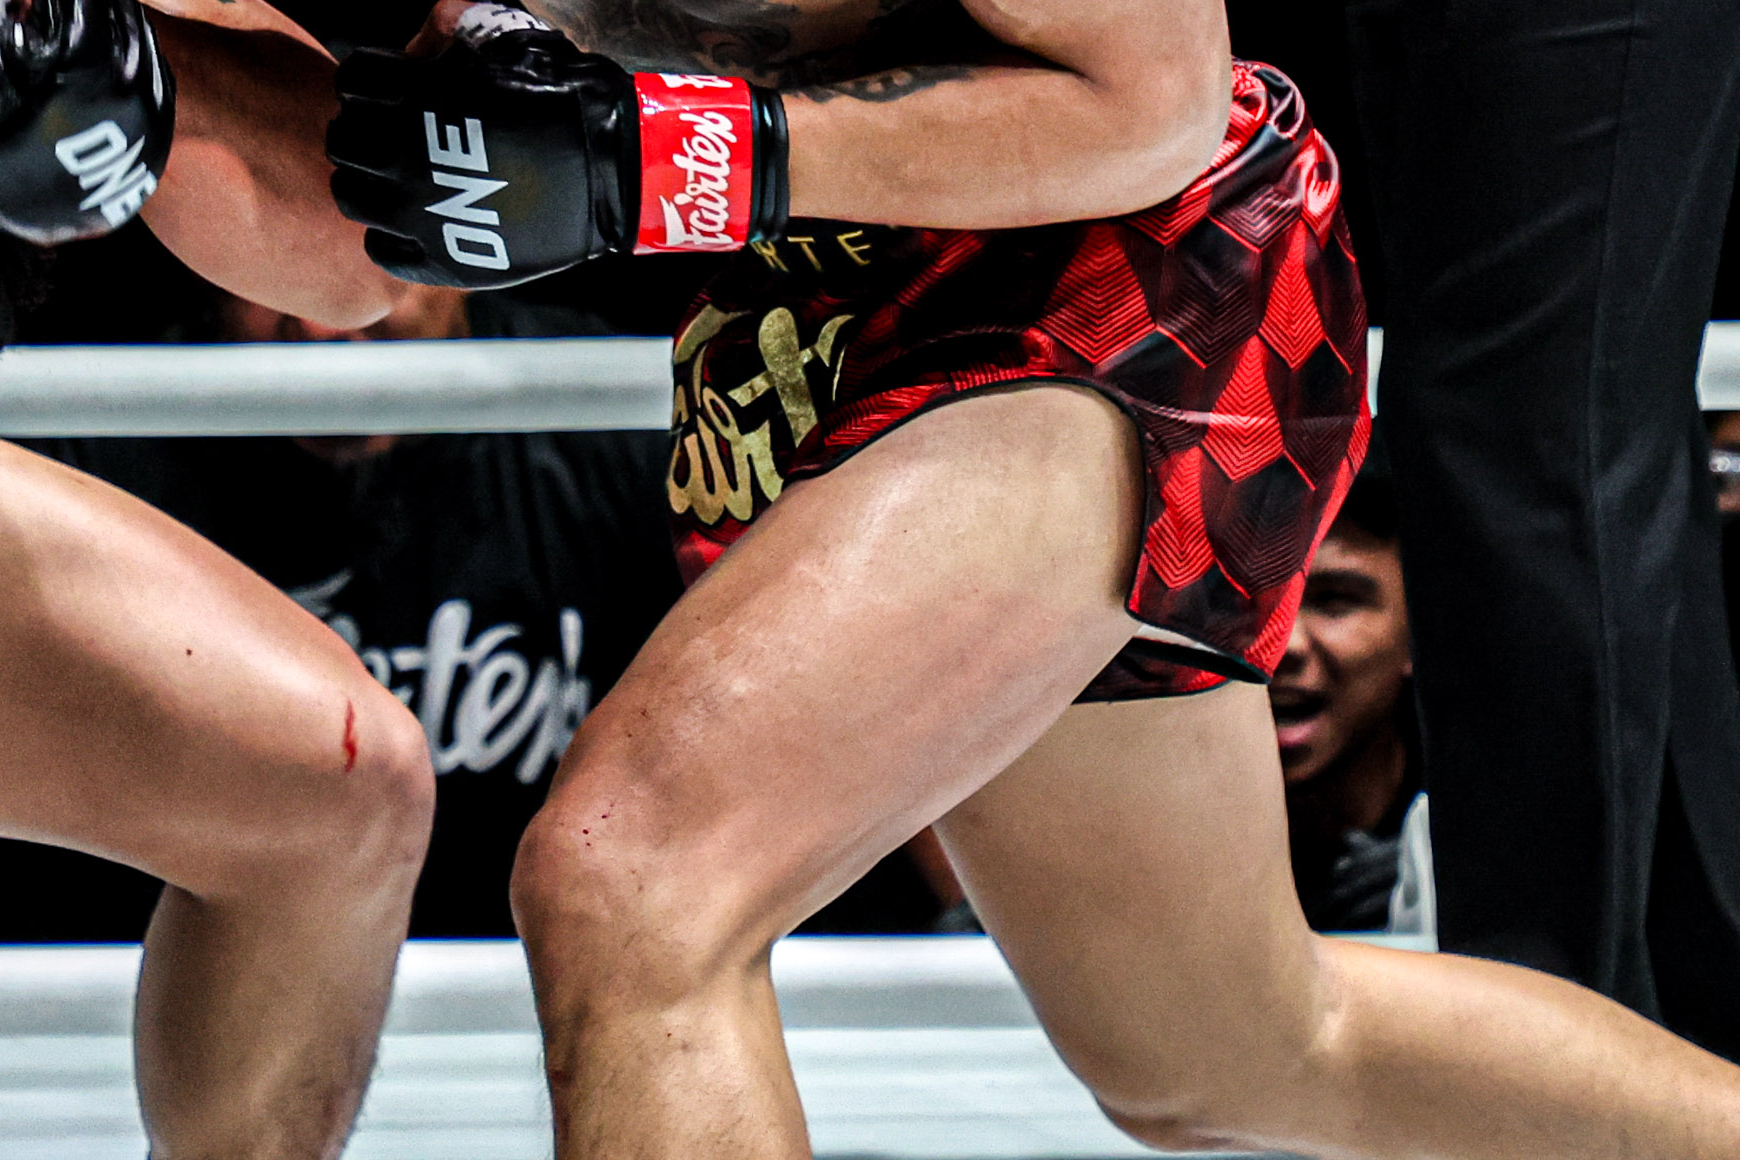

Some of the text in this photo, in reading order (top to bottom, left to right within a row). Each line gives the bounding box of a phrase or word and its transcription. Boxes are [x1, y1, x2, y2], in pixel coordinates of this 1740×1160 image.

[55, 120, 157, 228] ONE
[424, 111, 511, 271] ONE
[660, 111, 737, 246] Fairtex
